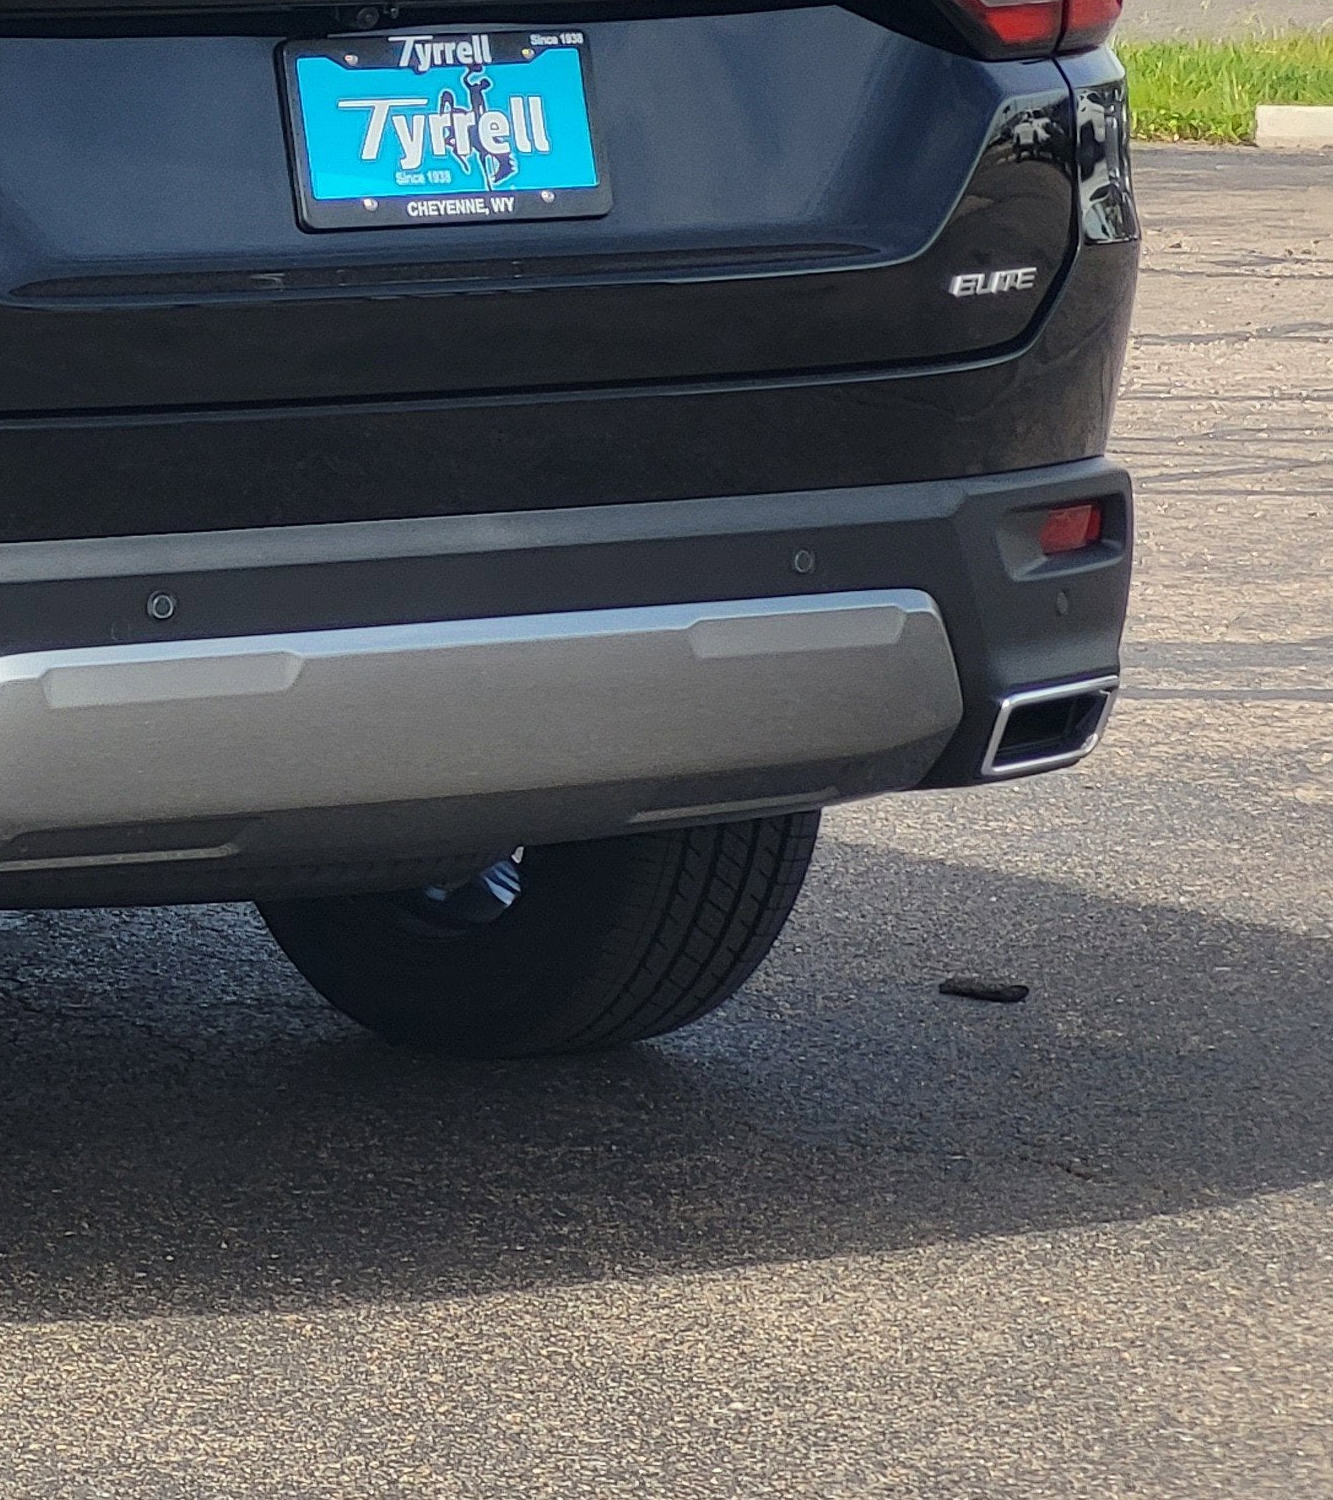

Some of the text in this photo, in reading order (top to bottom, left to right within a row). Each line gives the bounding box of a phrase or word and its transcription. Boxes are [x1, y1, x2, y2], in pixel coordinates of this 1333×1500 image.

[388, 35, 491, 71] Tyrrell
[338, 97, 549, 170] Tyrrell
[491, 197, 514, 213] WY
[949, 267, 1037, 297] ELITE
